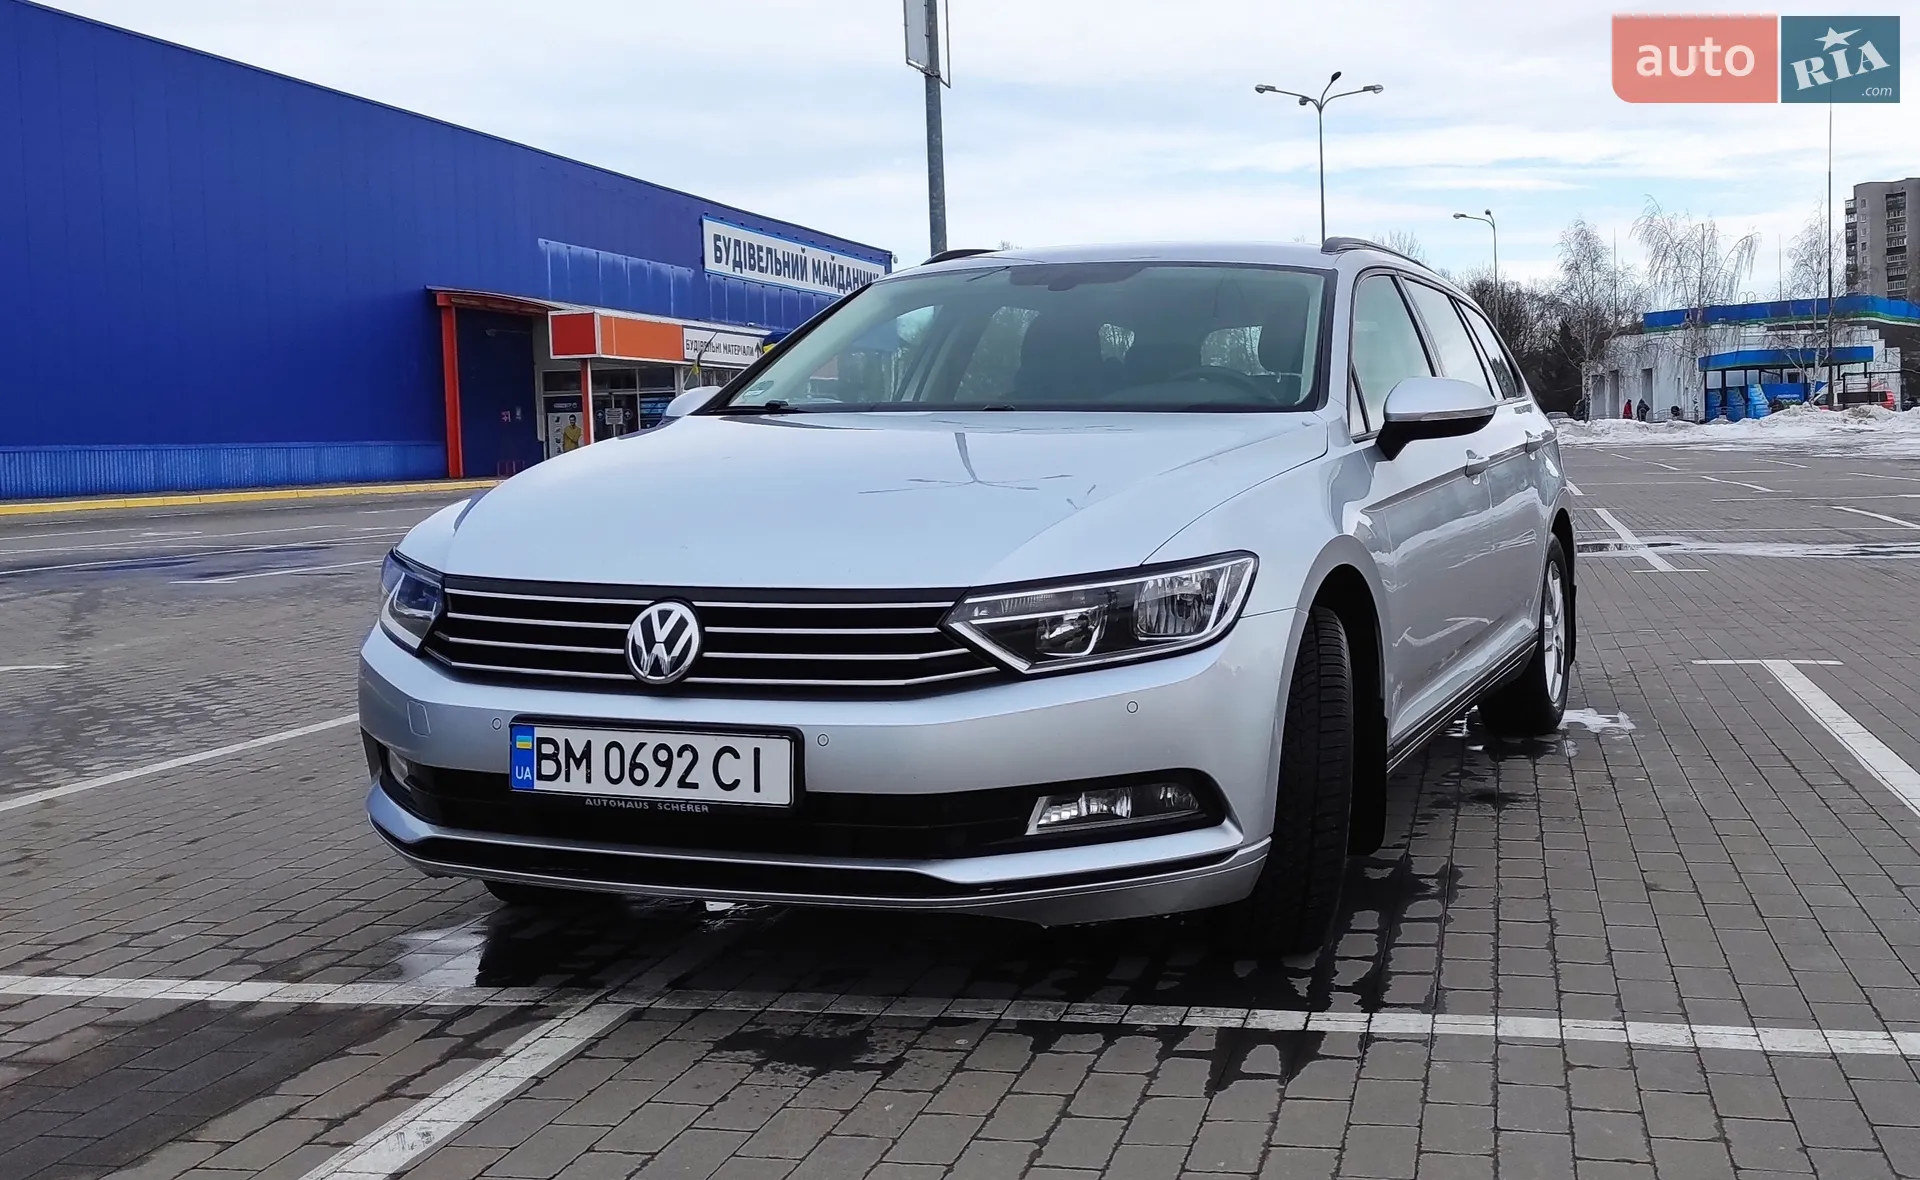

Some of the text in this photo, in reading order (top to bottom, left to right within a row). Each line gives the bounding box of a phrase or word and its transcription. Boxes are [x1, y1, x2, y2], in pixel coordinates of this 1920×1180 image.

[713, 233, 808, 282] БУДІВЕЛЬНИЙ
[722, 341, 755, 357] МАТЕРІАЛИ
[535, 736, 592, 784] BM
[604, 740, 700, 789] 0692
[515, 764, 532, 780] UA
[585, 798, 709, 813] AUTOHAUS SCHERER
